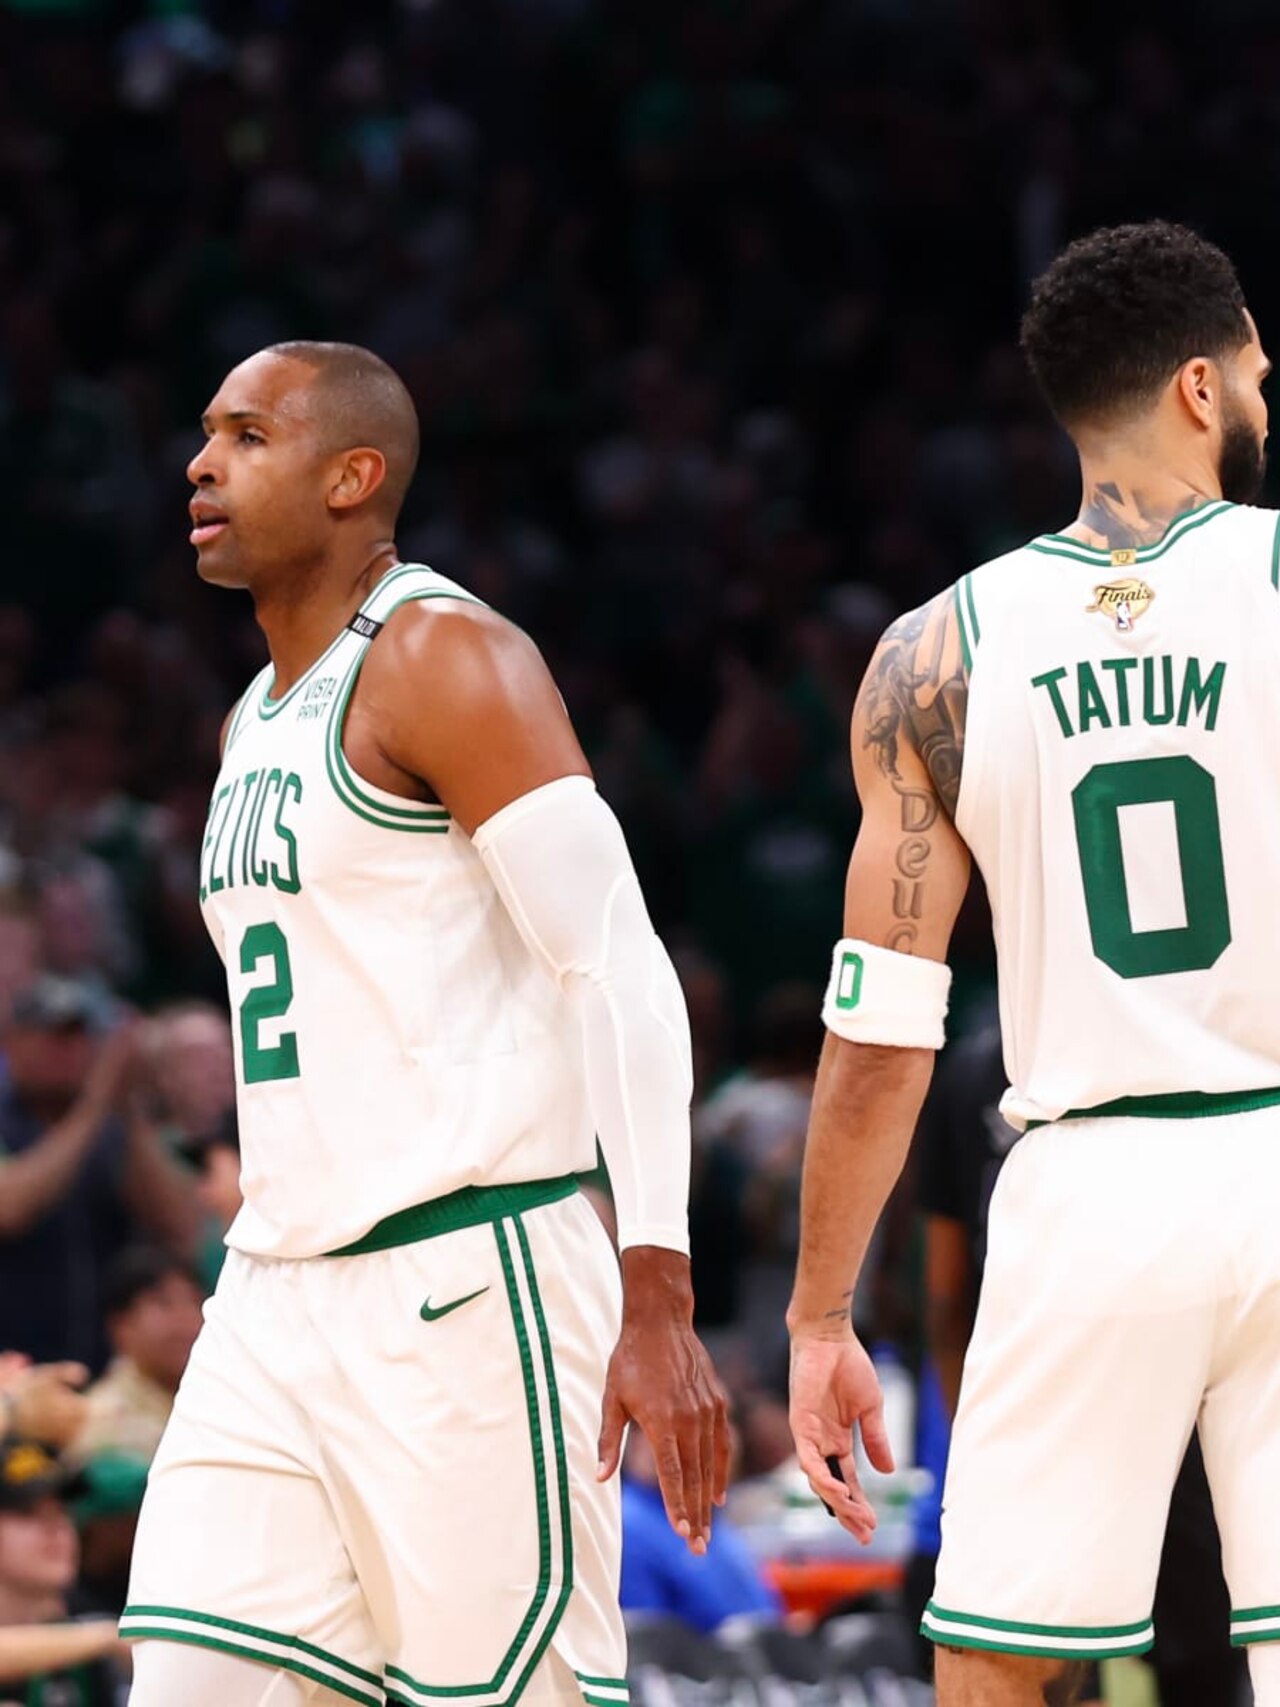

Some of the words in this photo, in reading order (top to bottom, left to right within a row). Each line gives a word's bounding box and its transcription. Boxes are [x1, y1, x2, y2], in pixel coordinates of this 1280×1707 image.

[1095, 583, 1153, 605] Finals
[1031, 655, 1226, 738] TATUM
[199, 767, 303, 904] ELTICS
[1071, 755, 1231, 979] 0
[239, 922, 300, 1084] 2
